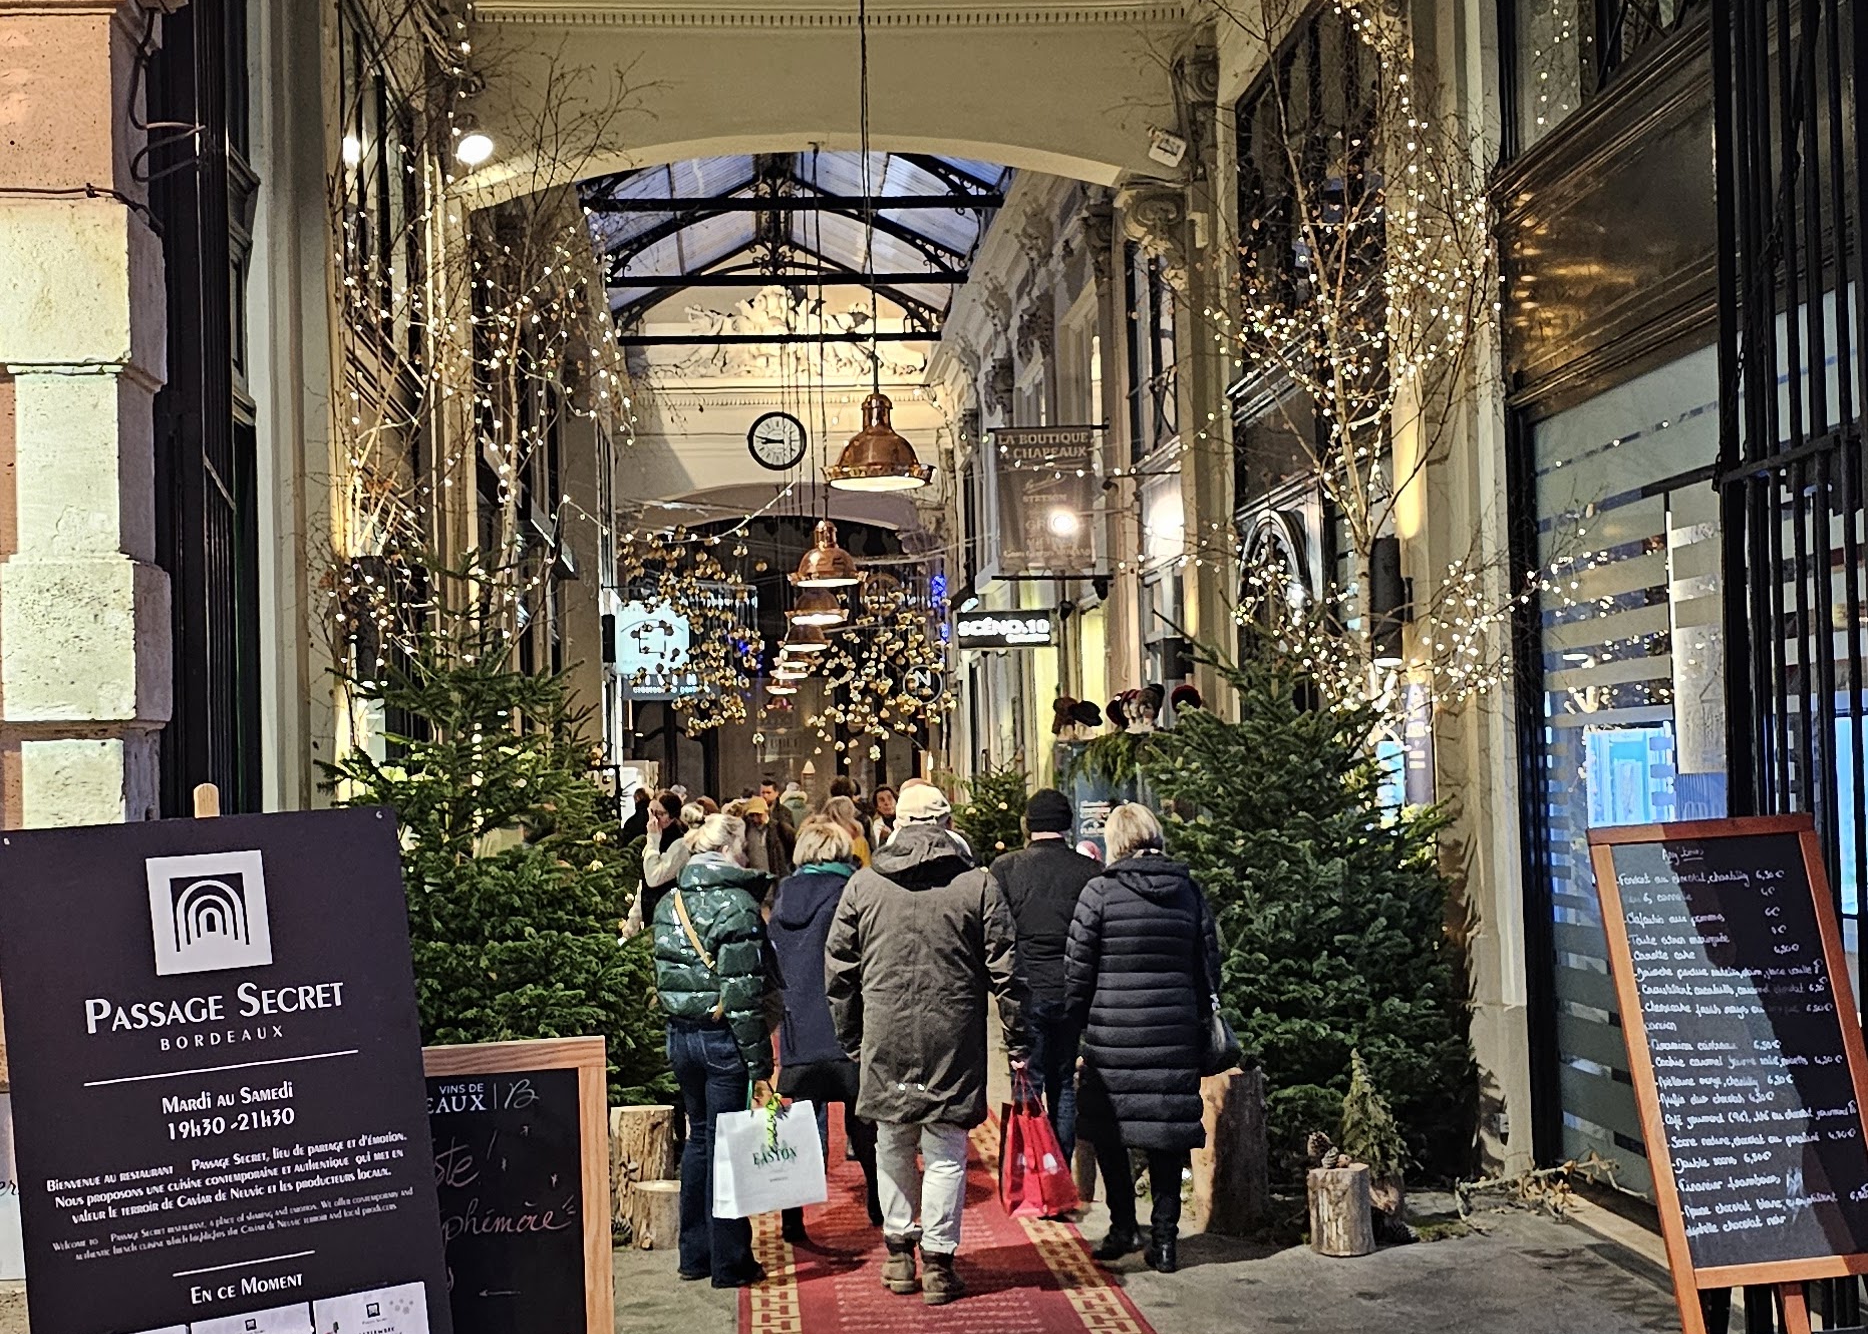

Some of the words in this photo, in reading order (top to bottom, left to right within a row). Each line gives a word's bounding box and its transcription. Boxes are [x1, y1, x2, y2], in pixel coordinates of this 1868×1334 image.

[997, 433, 1015, 445] LA
[1019, 432, 1088, 445] BOUTIQUE
[1013, 446, 1088, 459] CHAPEAUX
[84, 995, 226, 1034] PASSAGE
[236, 981, 344, 1018] SECRET
[159, 1024, 283, 1052] BORDEAUX
[439, 1084, 466, 1095] VINS
[468, 1082, 485, 1093] DE
[167, 1116, 226, 1141] 19h30
